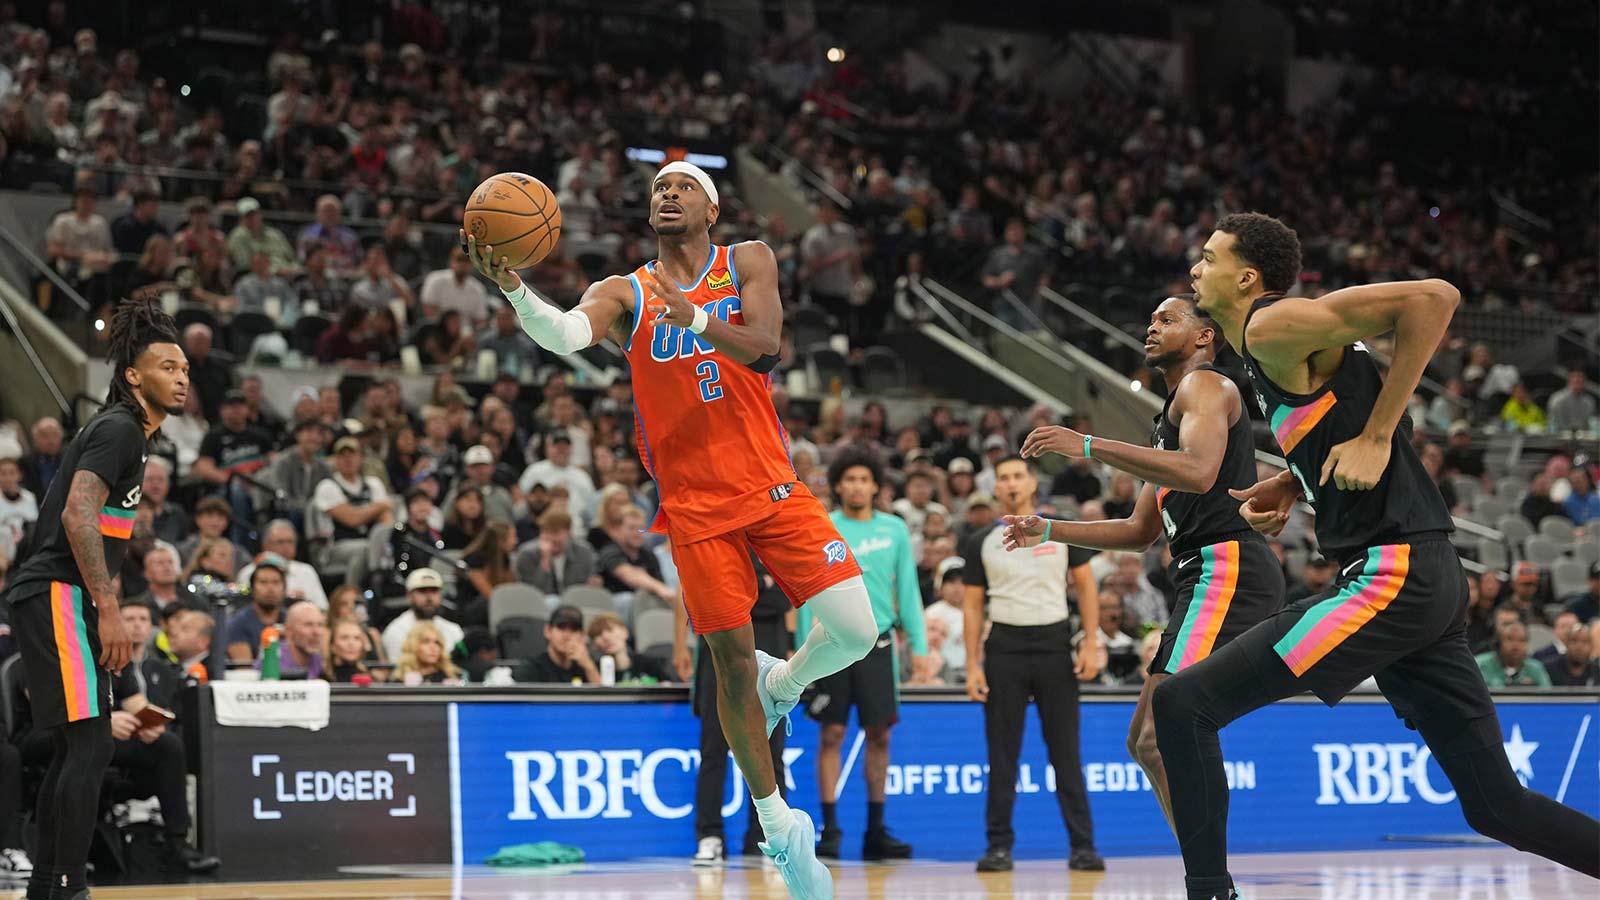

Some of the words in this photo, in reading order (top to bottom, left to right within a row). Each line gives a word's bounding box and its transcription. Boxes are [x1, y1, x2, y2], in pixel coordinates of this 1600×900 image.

[696, 360, 724, 403] 2
[276, 769, 394, 802] LEDGER
[884, 763, 1040, 795] OFFICL
[1045, 762, 1153, 793] CEDIT
[1312, 742, 1457, 804] RBFC
